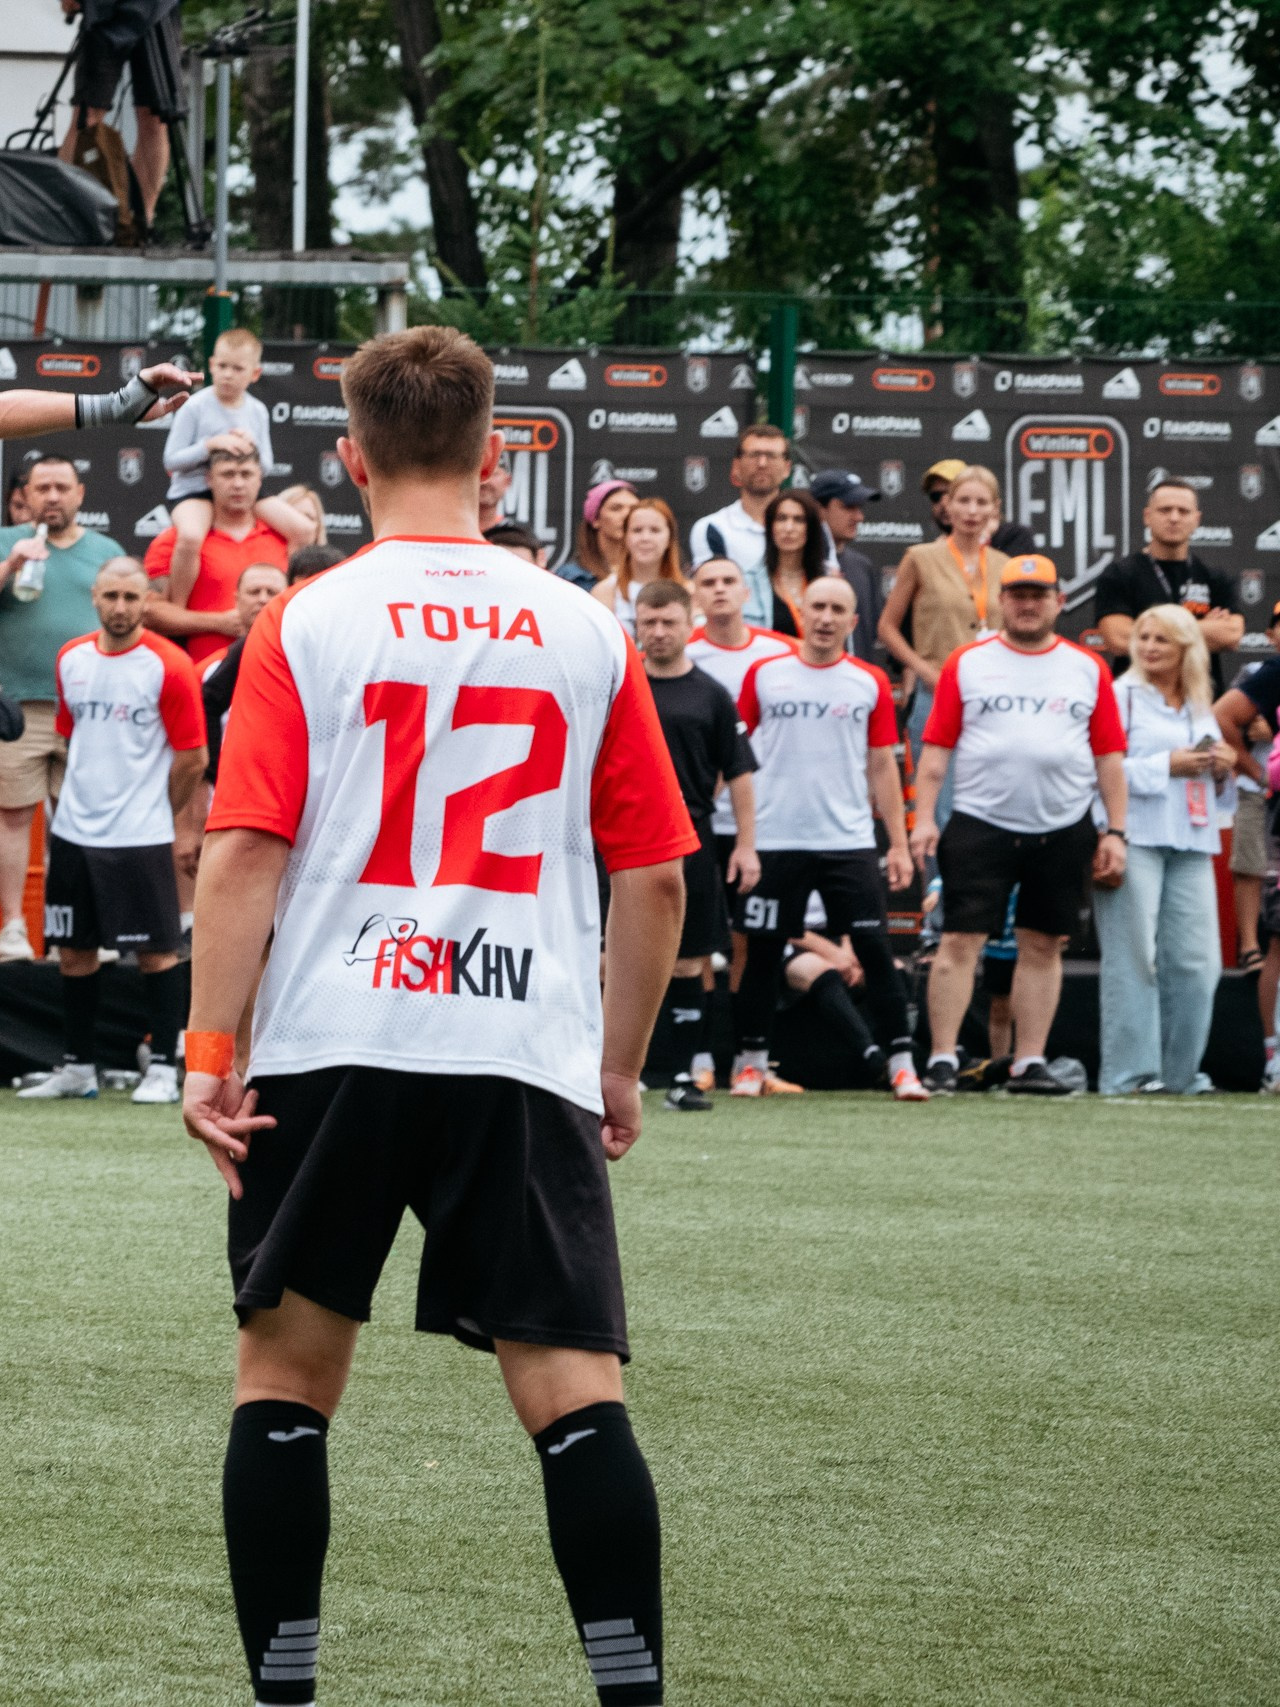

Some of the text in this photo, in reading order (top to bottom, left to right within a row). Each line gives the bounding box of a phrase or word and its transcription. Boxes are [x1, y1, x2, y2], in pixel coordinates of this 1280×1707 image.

[1014, 374, 1084, 388] ПАНОРАМА
[608, 412, 677, 426] ПАНОРАМА
[852, 416, 922, 430] ПАНОРАМА
[1163, 420, 1232, 435] ПАНОРАМА
[1030, 436, 1088, 452] Winline
[1021, 459, 1115, 548] EML
[387, 602, 545, 648] ГОЧА
[358, 680, 569, 896] 12
[743, 895, 779, 930] 91
